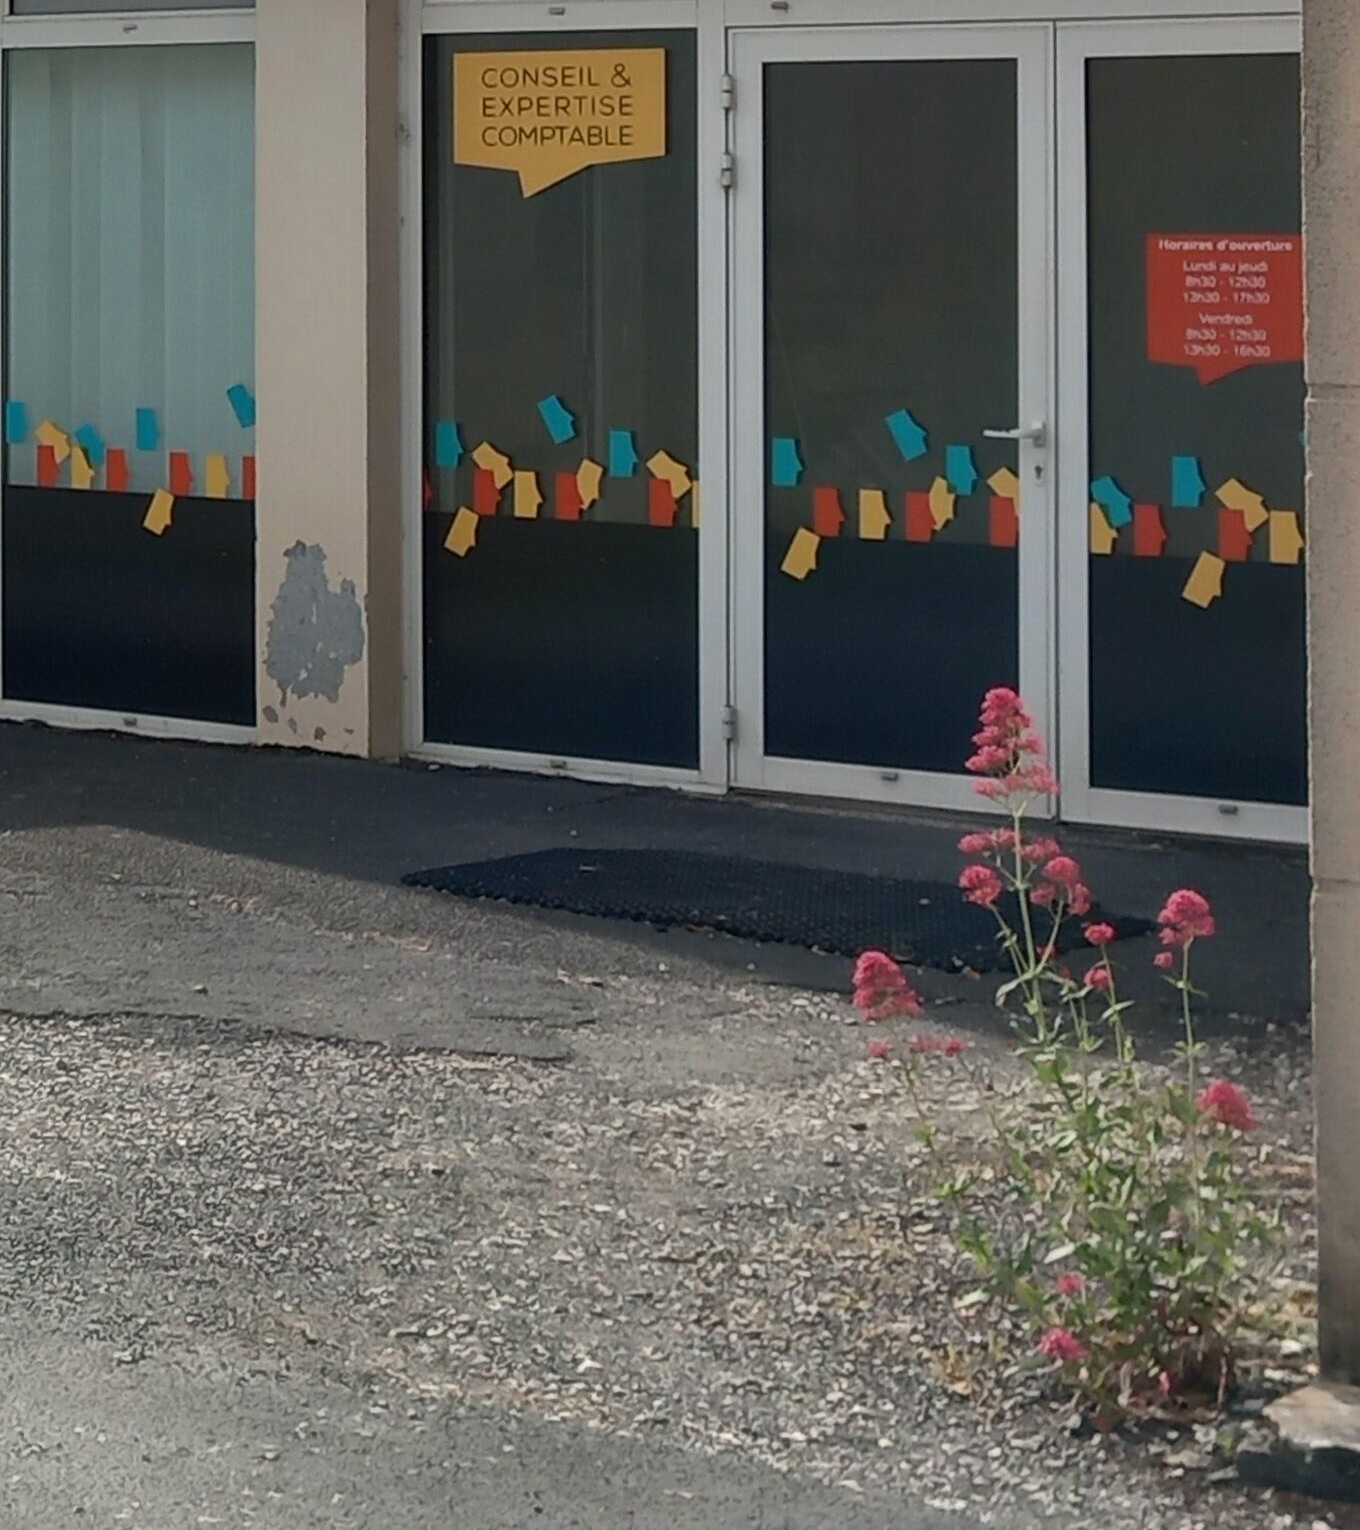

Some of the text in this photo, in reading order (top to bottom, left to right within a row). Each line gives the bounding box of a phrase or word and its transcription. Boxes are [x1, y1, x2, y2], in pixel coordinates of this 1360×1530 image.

[481, 63, 632, 88] CONSEIL &
[482, 95, 634, 117] EXPERTISE
[481, 125, 634, 147] COMPTABLE
[1158, 239, 1293, 251] Horaires d'ouverture
[1183, 261, 1269, 274] Lundi au jeudi
[1198, 312, 1253, 325] Vendredi
